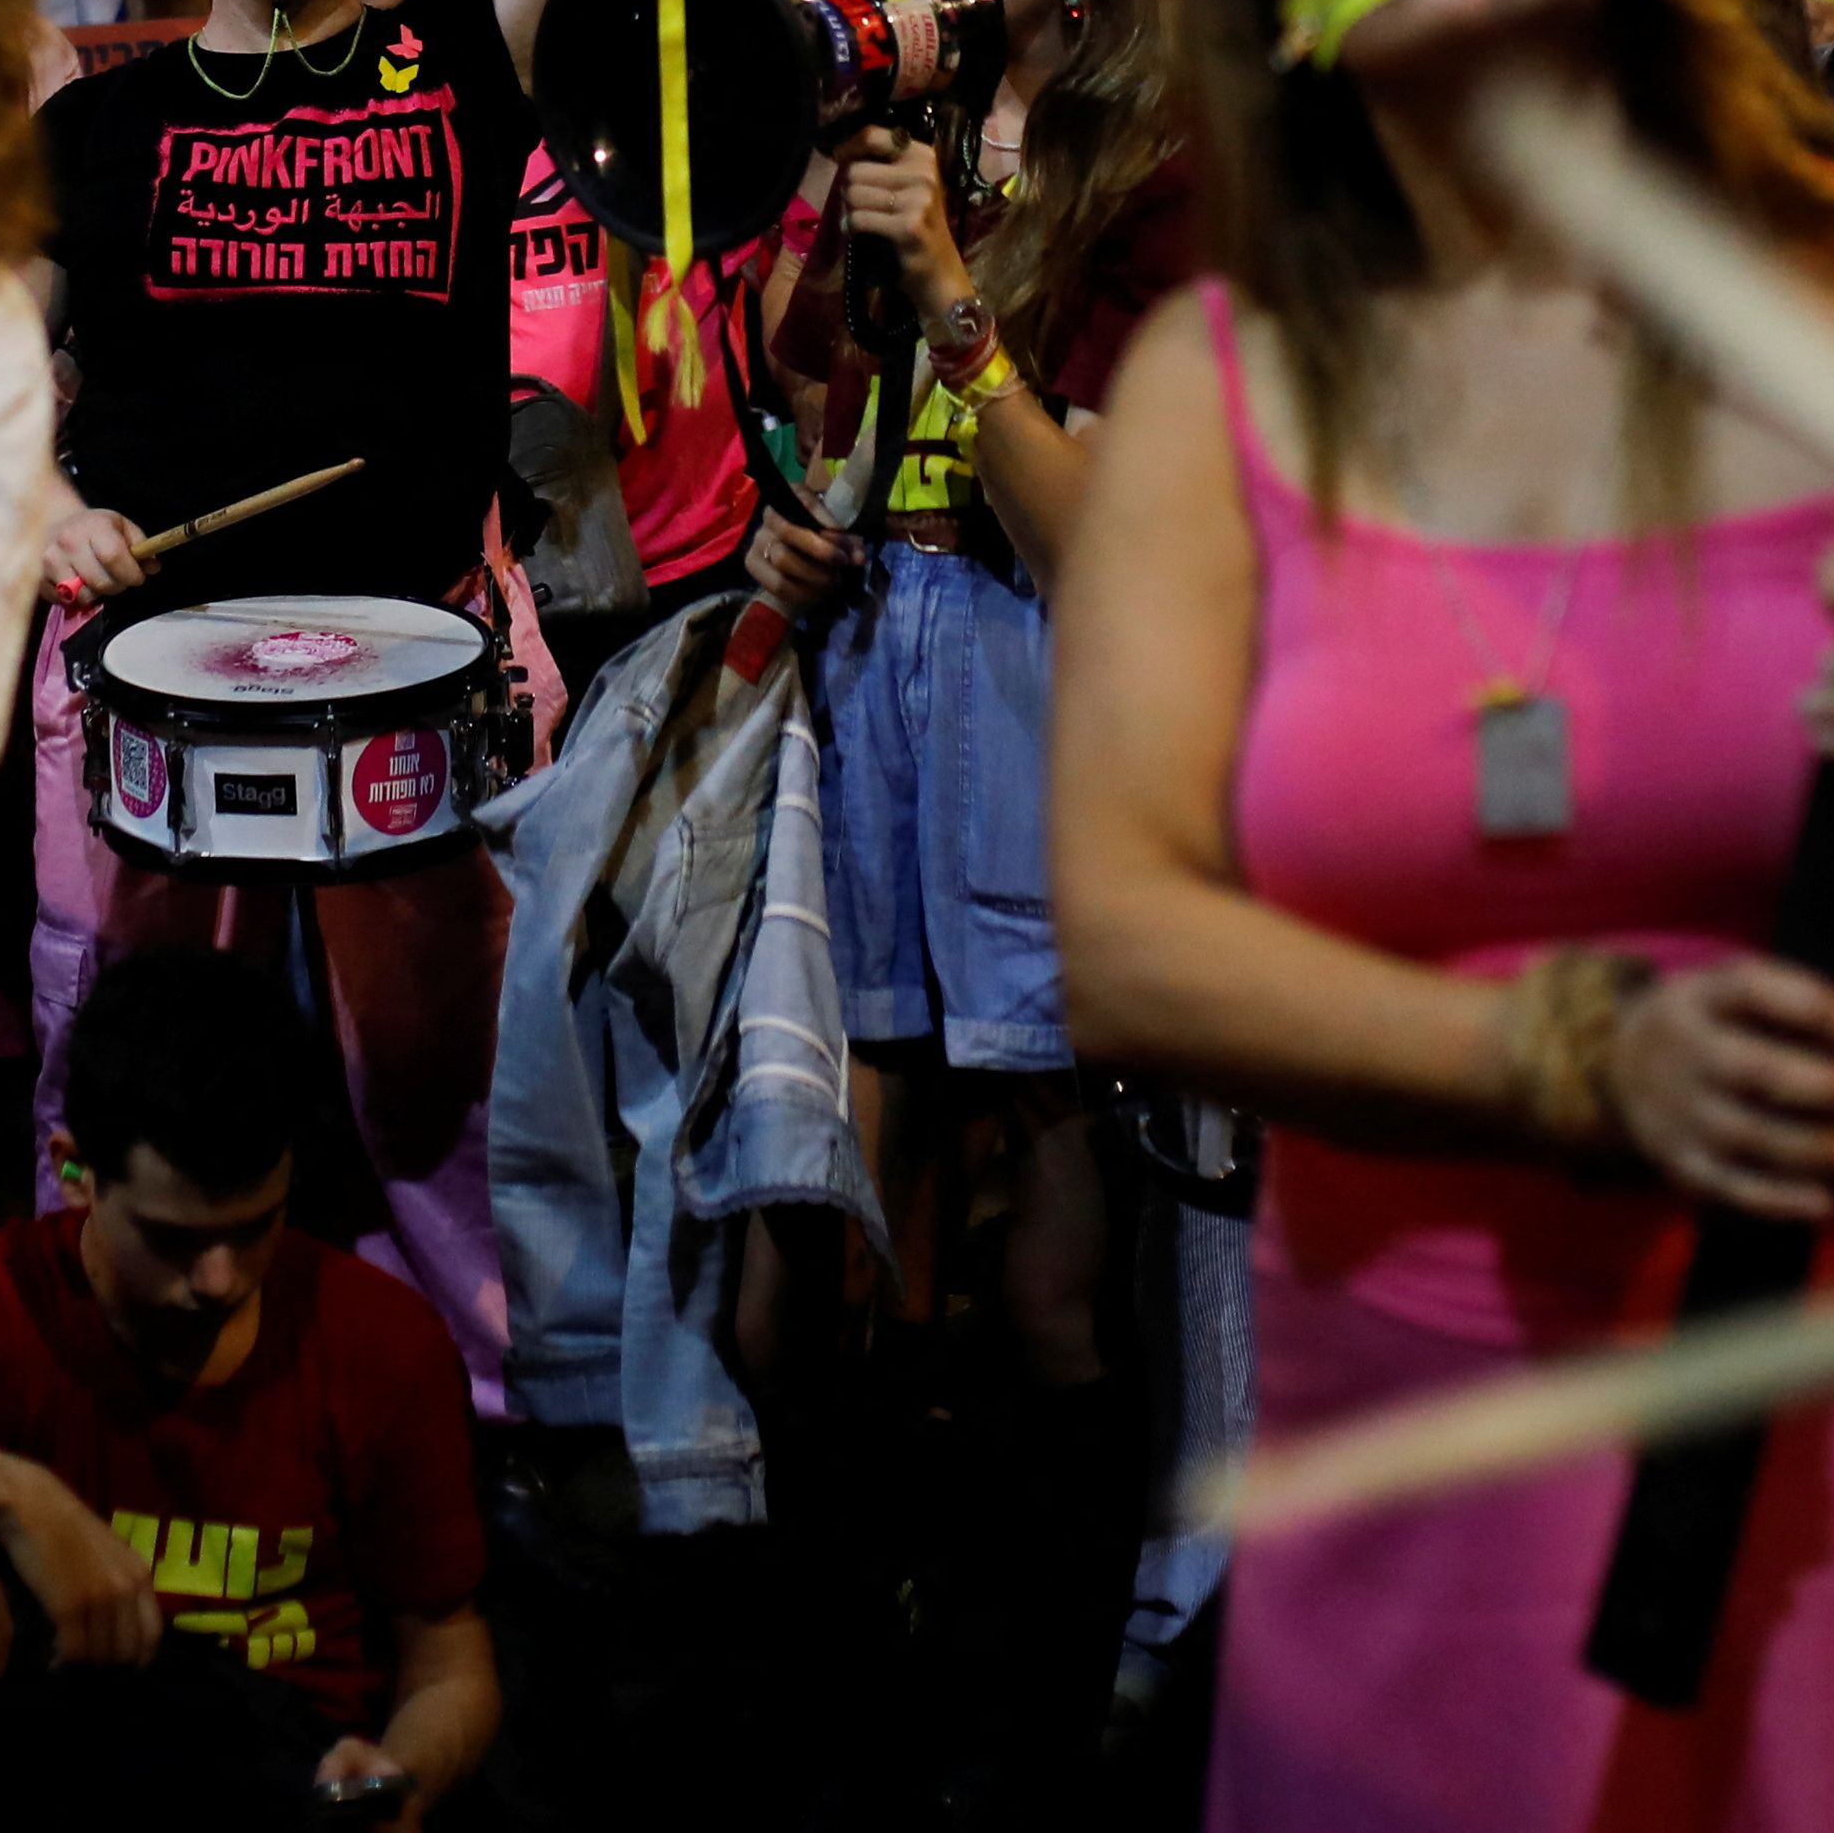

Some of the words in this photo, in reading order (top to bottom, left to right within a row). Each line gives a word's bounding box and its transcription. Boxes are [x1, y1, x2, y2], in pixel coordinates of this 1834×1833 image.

[181, 124, 433, 189] PINKFRONT
[177, 188, 310, 236] الوردية
[325, 189, 441, 233] الجبهة
[171, 236, 306, 279] הורודה
[324, 240, 438, 279] החזית
[222, 781, 287, 811] Stagg
